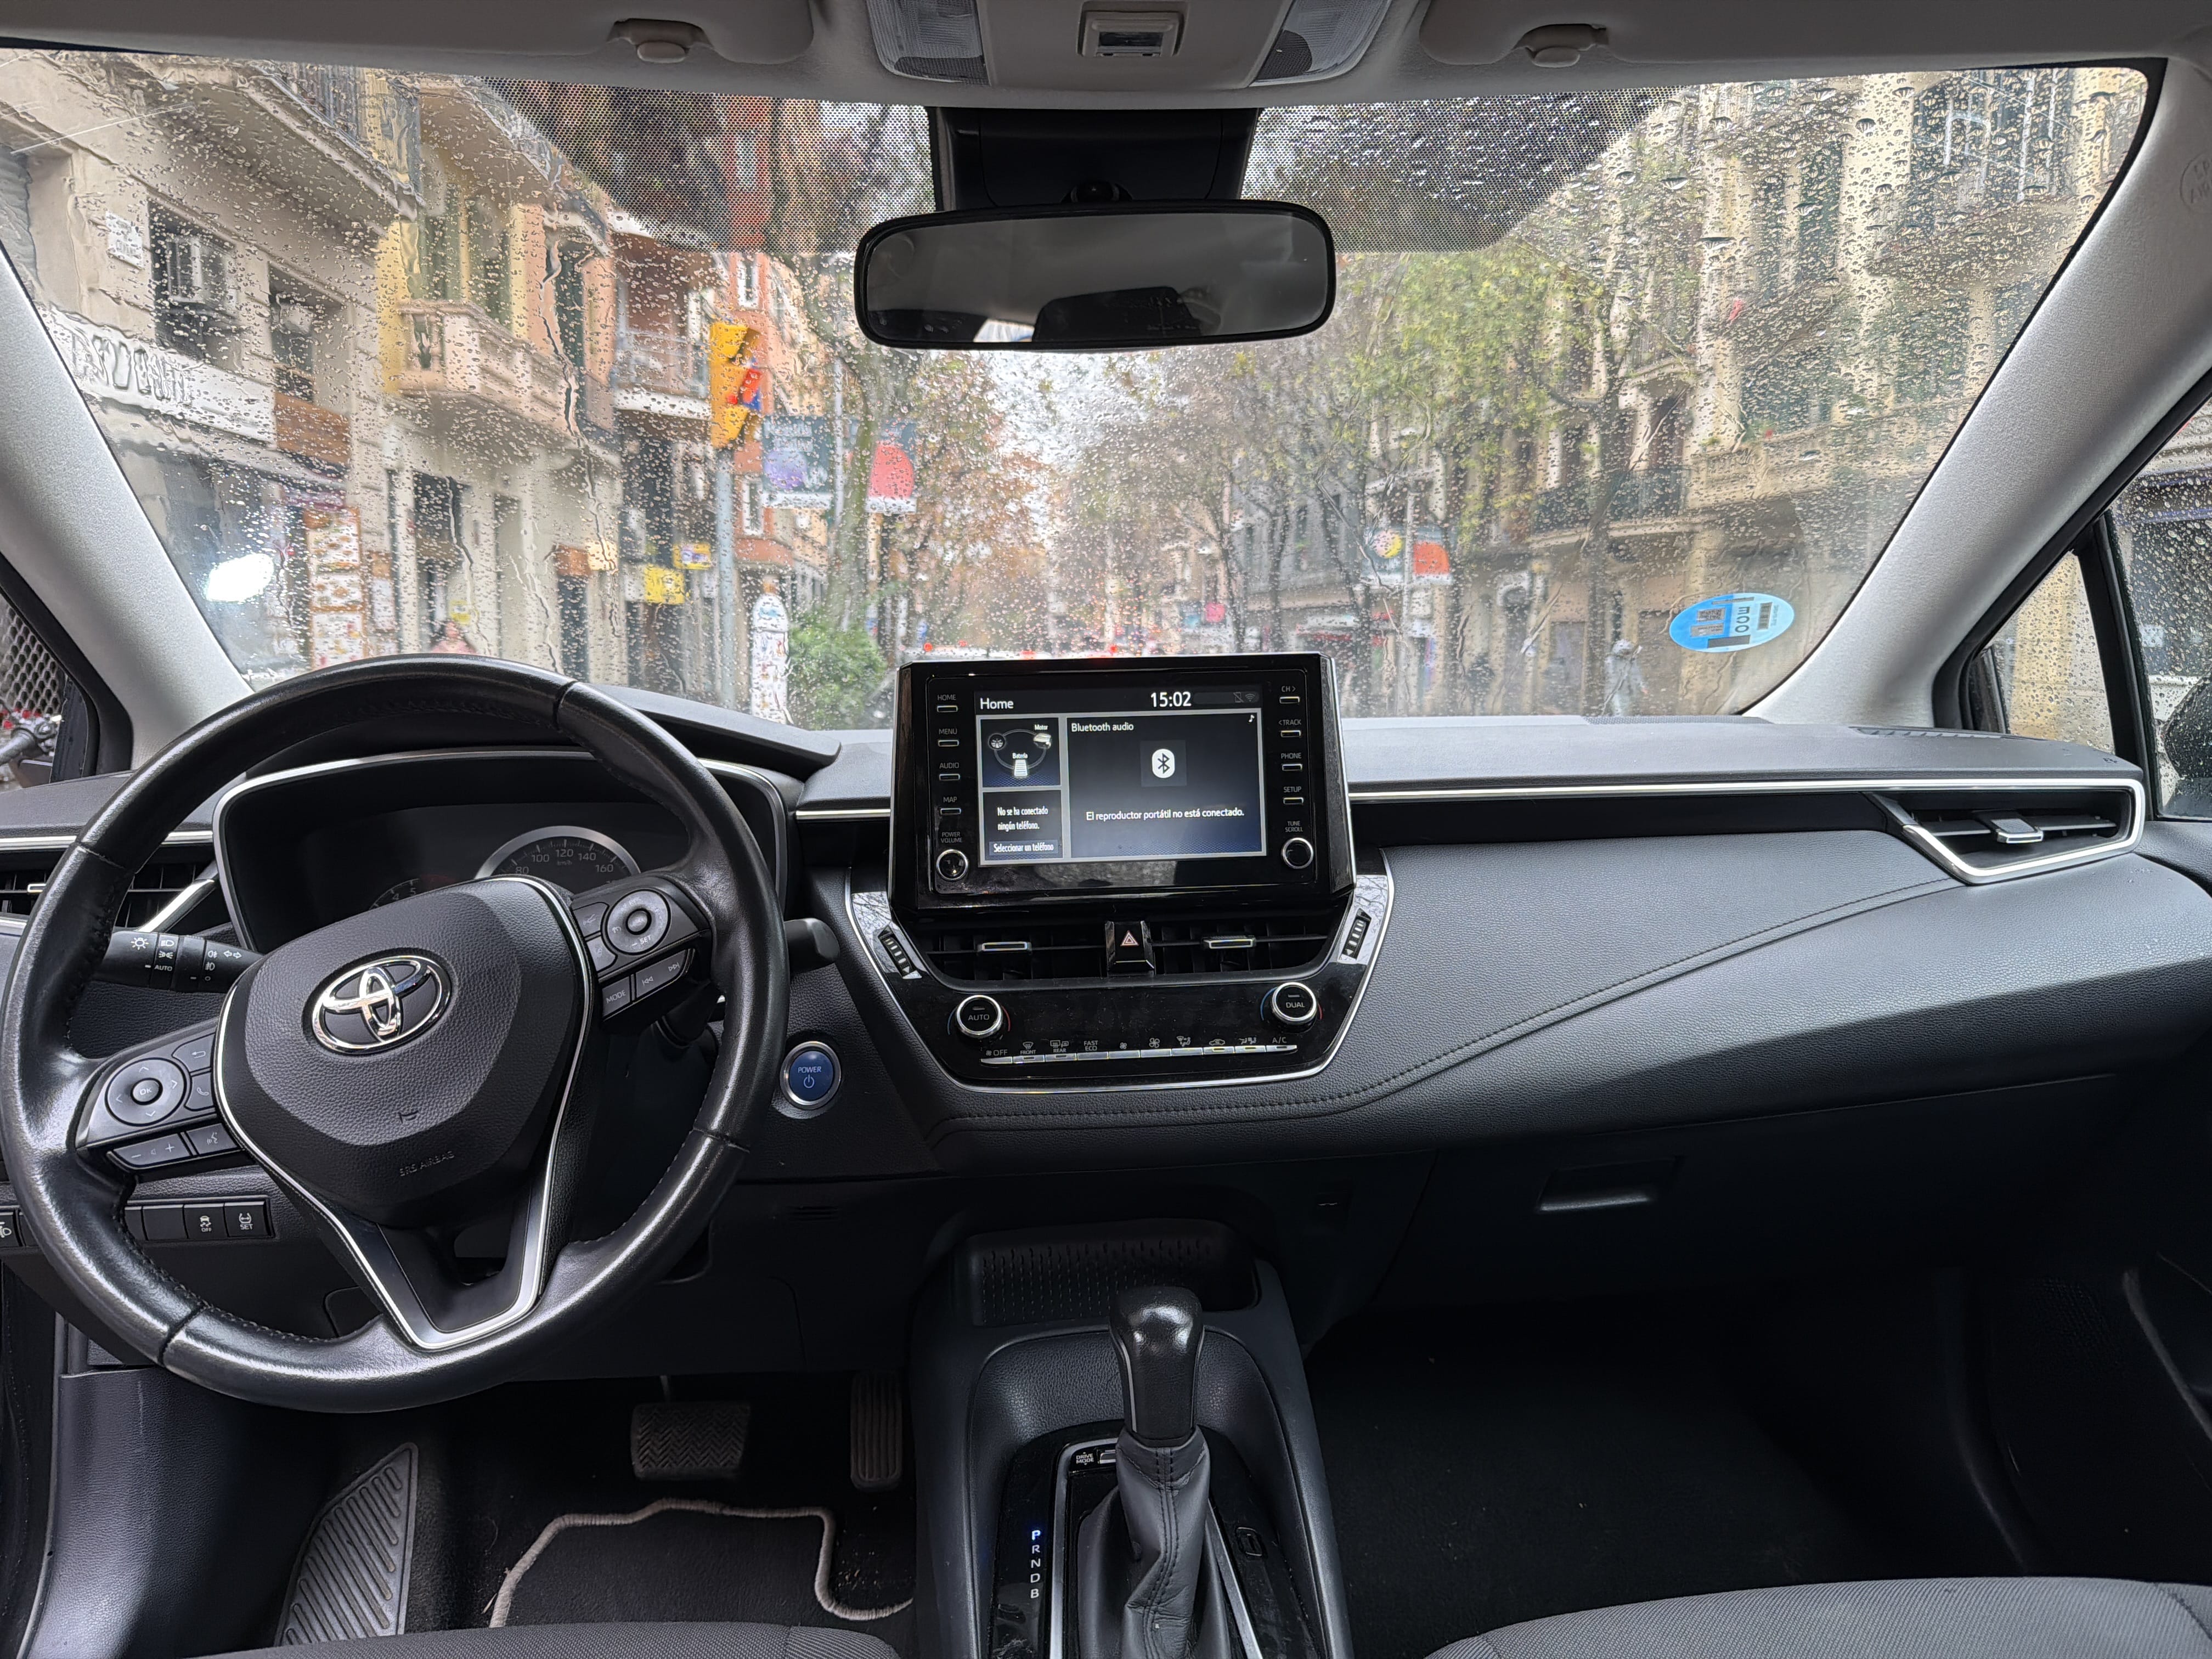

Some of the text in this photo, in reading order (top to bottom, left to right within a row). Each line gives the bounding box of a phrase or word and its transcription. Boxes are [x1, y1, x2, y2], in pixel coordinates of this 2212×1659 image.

[980, 697, 1014, 710] Home
[1150, 691, 1192, 708] 15:02
[1071, 722, 1134, 732] Bluetooth audio
[997, 807, 1006, 816] No
[1013, 806, 1020, 815] ha
[1021, 806, 1048, 815] conectado
[1086, 811, 1094, 821] El
[1096, 811, 1142, 821] reproductor
[1143, 809, 1171, 821] portátil
[1184, 808, 1200, 817] está
[1202, 807, 1244, 817] conectado.
[997, 820, 1040, 832] ningún teléfono.
[994, 843, 1024, 853] Seleccionar
[1032, 842, 1054, 851] teléfono
[531, 854, 550, 862] 100
[556, 849, 574, 857] 120
[578, 853, 596, 861] 140
[515, 866, 529, 874] 80
[595, 864, 614, 872] 160
[640, 935, 652, 945] SET
[606, 989, 627, 1003] MODE
[1031, 1530, 1041, 1541] P
[1032, 1544, 1041, 1554] R
[1031, 1558, 1041, 1568] N
[1030, 1573, 1040, 1583] D
[1030, 1588, 1039, 1599] B
